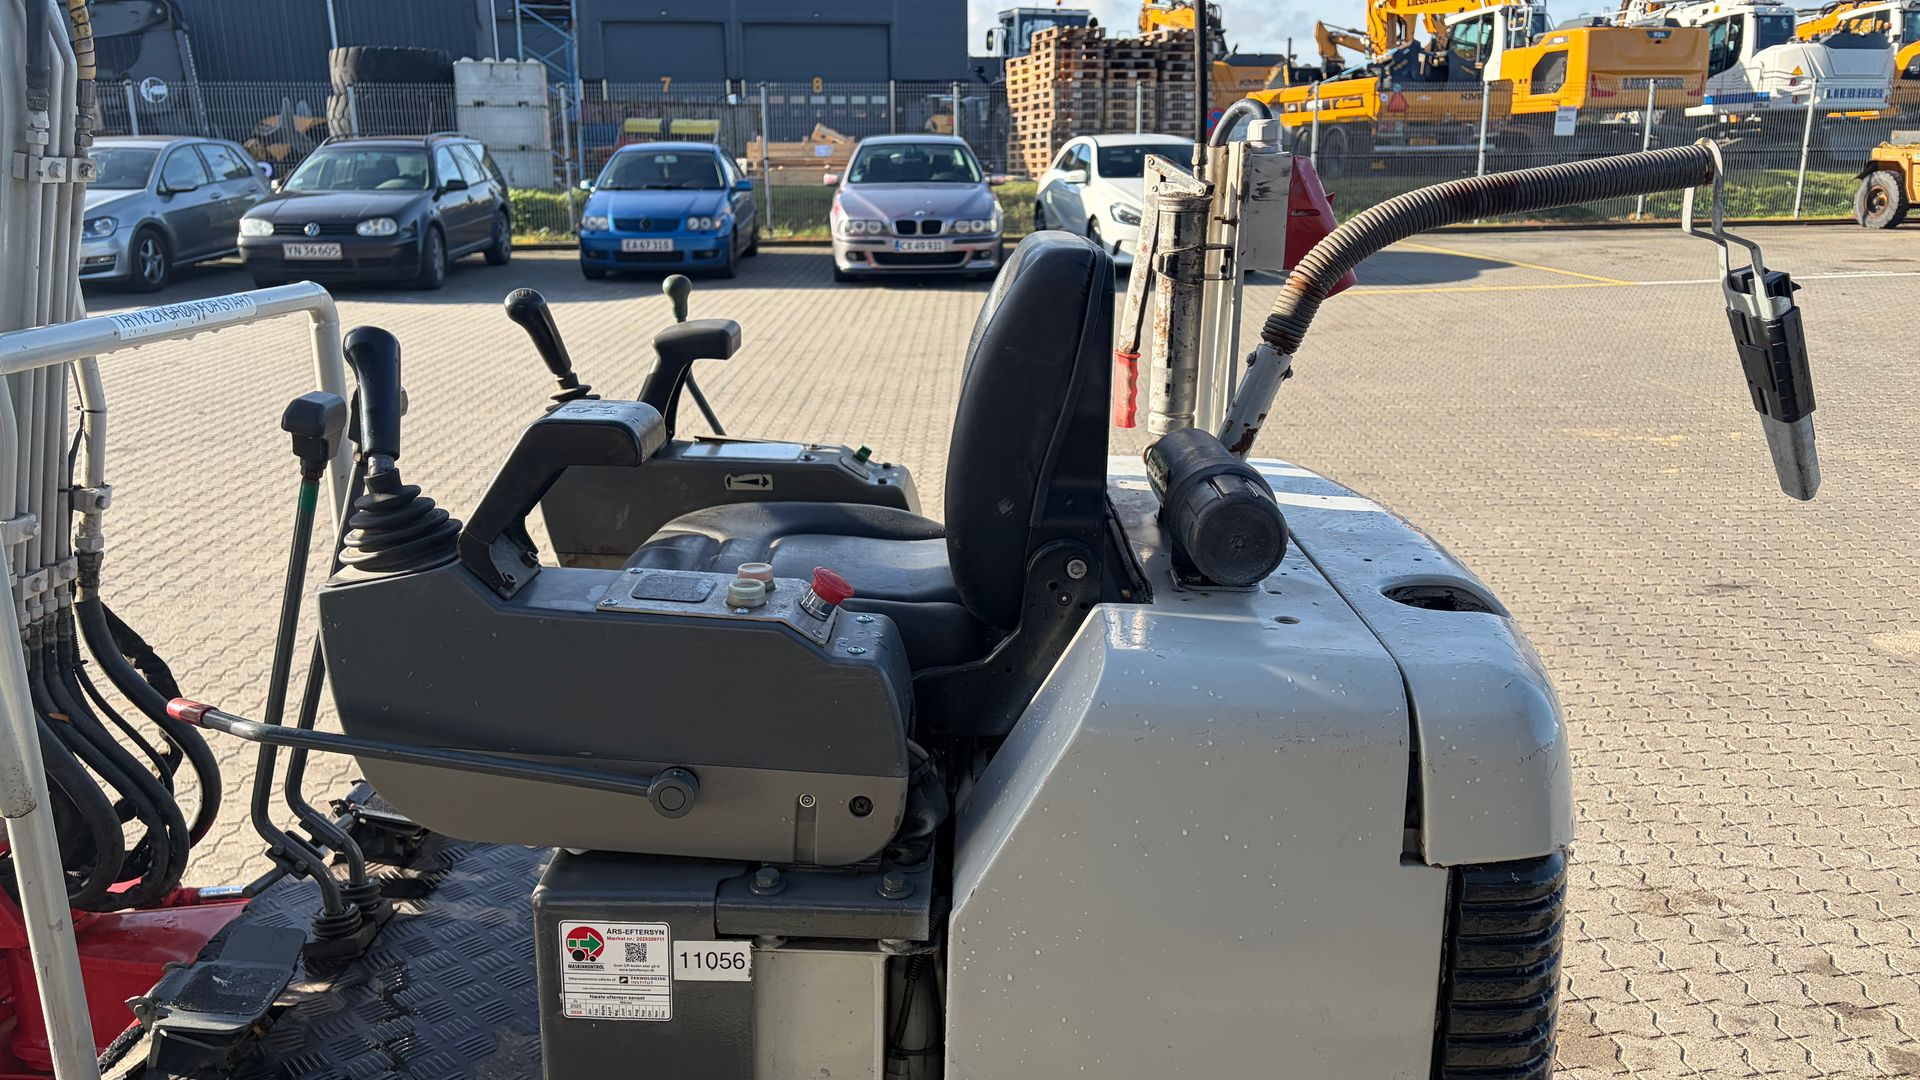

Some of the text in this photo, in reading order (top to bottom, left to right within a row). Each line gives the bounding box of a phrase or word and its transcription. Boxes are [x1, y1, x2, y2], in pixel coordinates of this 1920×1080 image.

[660, 76, 672, 93] 7
[811, 76, 824, 93] 8
[110, 294, 254, 329] TRYK 2X GRØN FOR START
[680, 951, 745, 970] 11056
